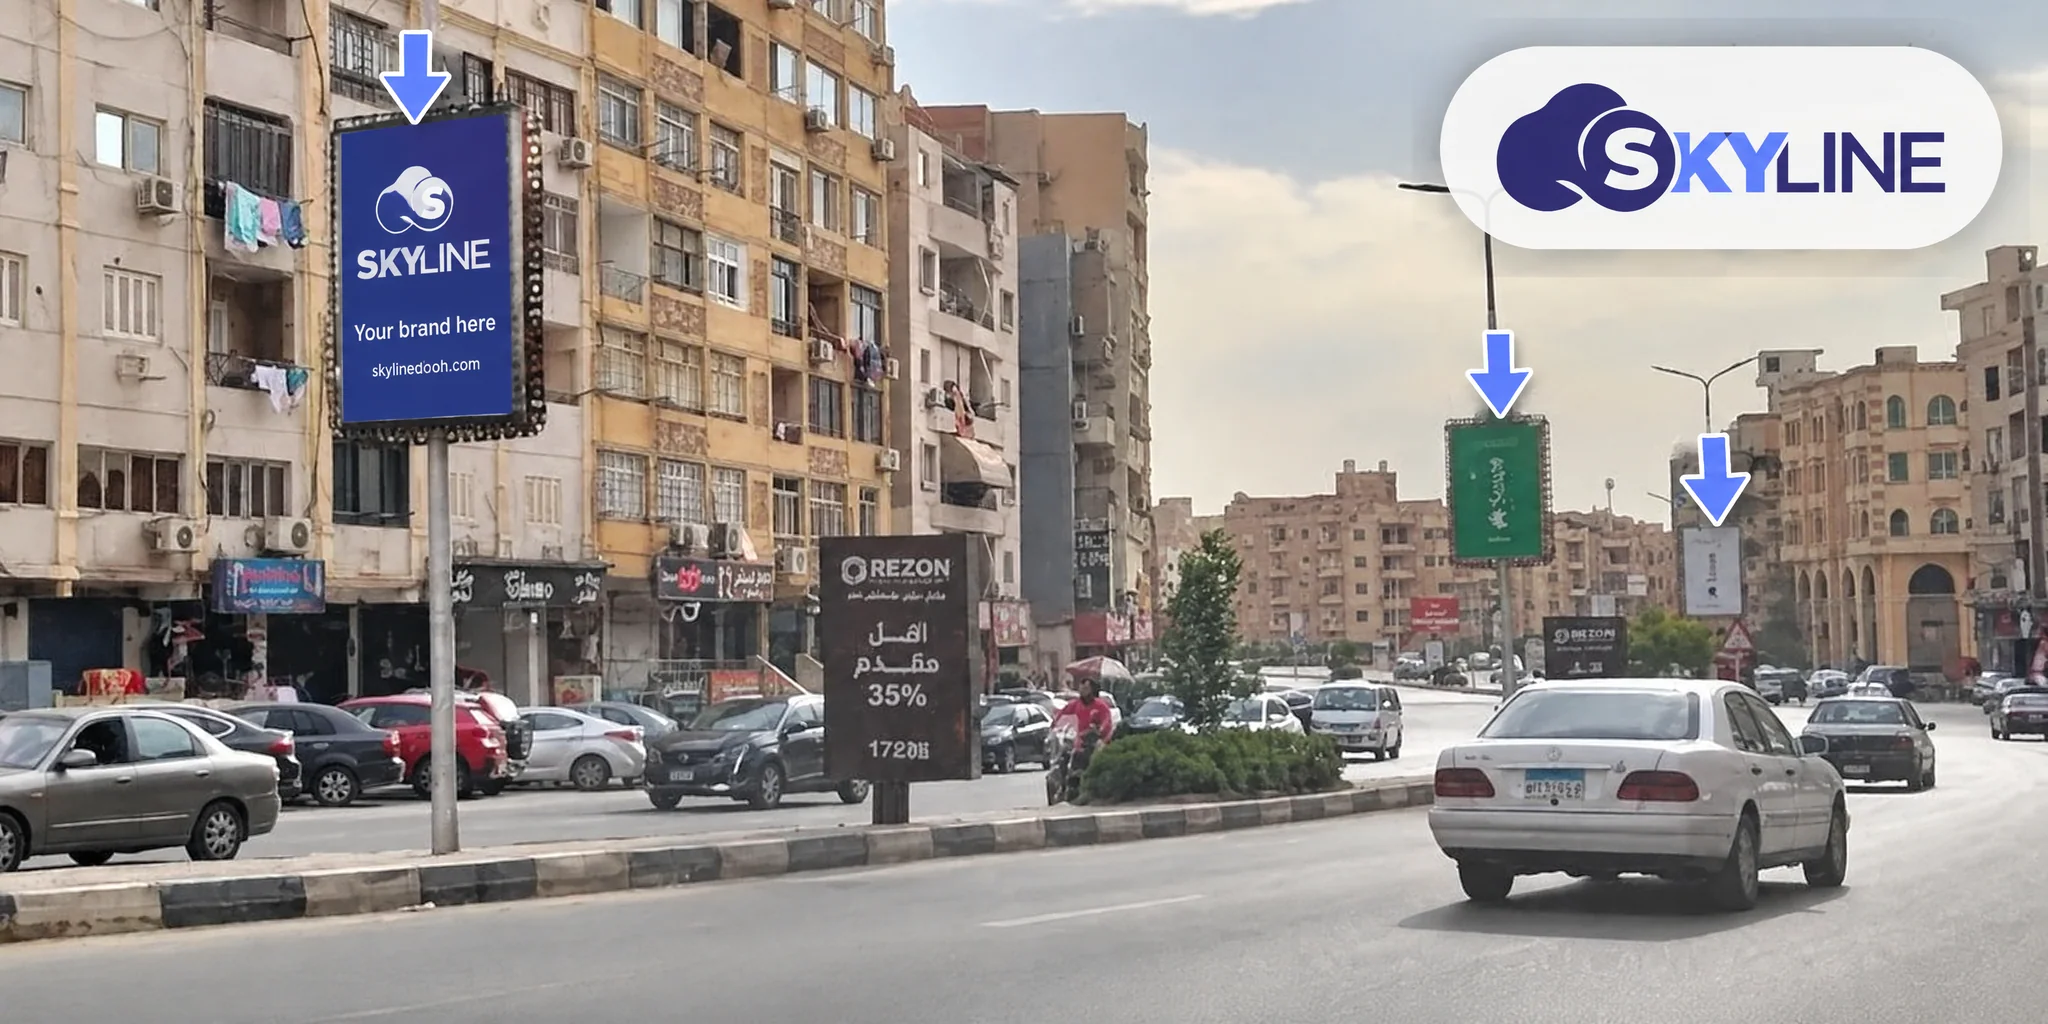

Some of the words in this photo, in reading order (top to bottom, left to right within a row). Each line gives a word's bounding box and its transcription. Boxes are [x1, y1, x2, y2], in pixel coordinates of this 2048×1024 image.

[357, 238, 491, 280] SKYLINE
[354, 324, 394, 342] Your
[399, 317, 451, 338] brand
[456, 315, 496, 334] here
[372, 358, 480, 378] skylinedooh.com
[870, 558, 951, 577] REZON
[868, 683, 927, 706] 35%
